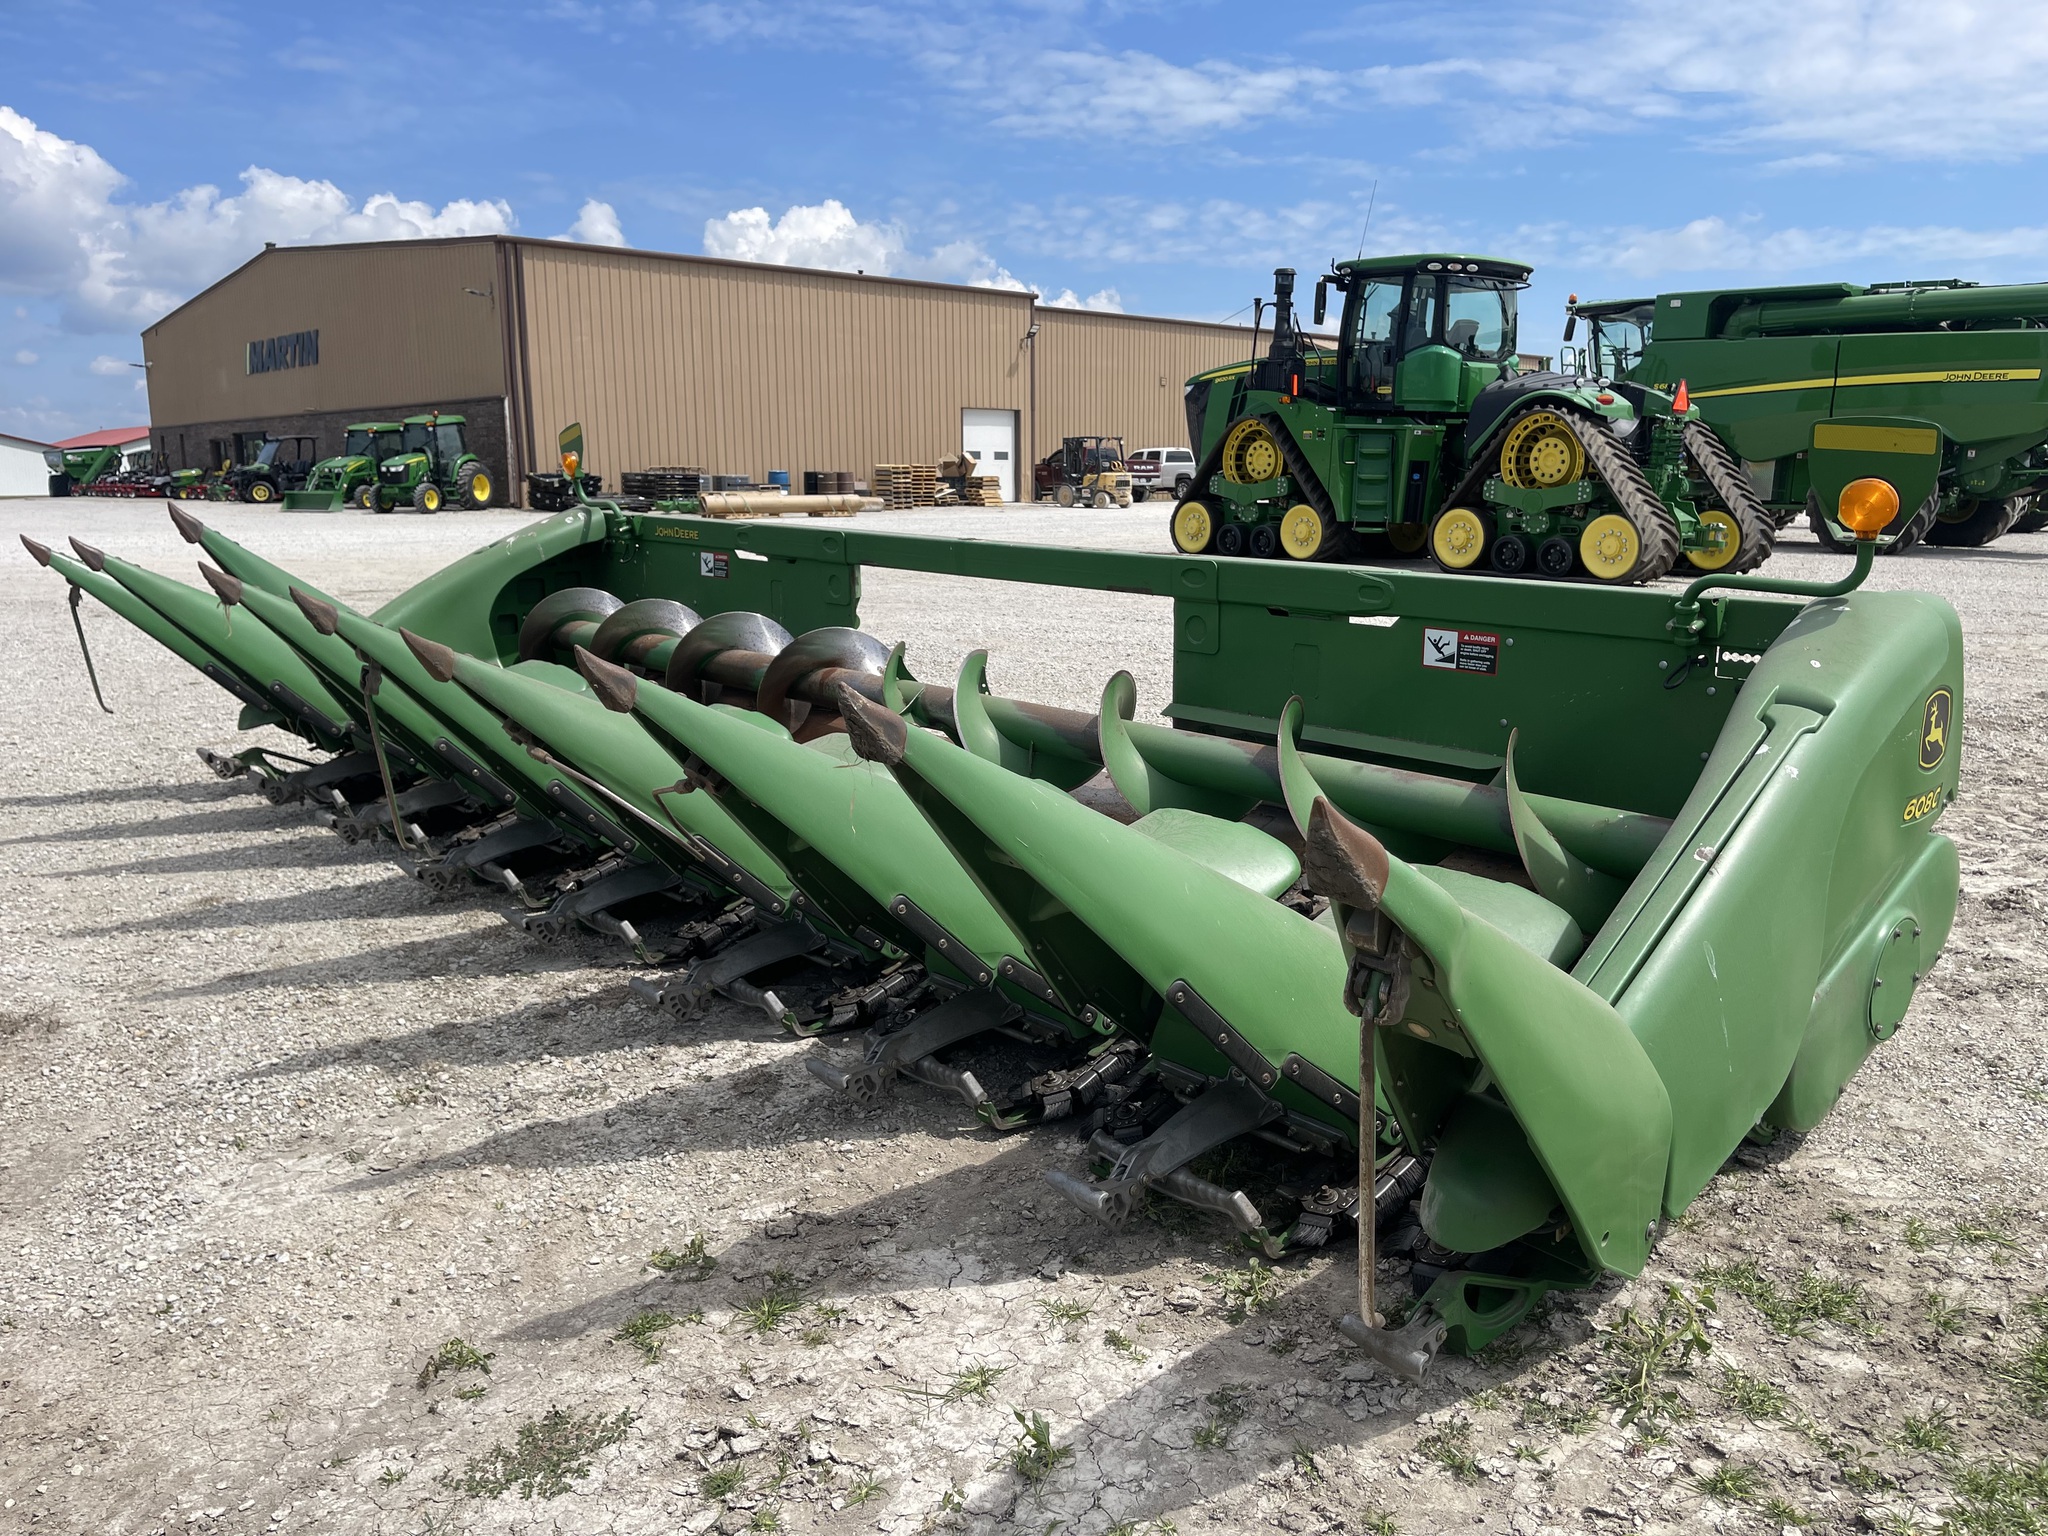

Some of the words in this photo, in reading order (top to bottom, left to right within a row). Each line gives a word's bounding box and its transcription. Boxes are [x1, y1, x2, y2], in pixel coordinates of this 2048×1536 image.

[248, 329, 318, 374] MARTIN
[1974, 372, 2009, 380] DEERE
[654, 525, 674, 537] JOHN
[674, 527, 699, 540] DEERE
[1470, 634, 1495, 642] DANGER
[1903, 786, 1942, 822] 608C
